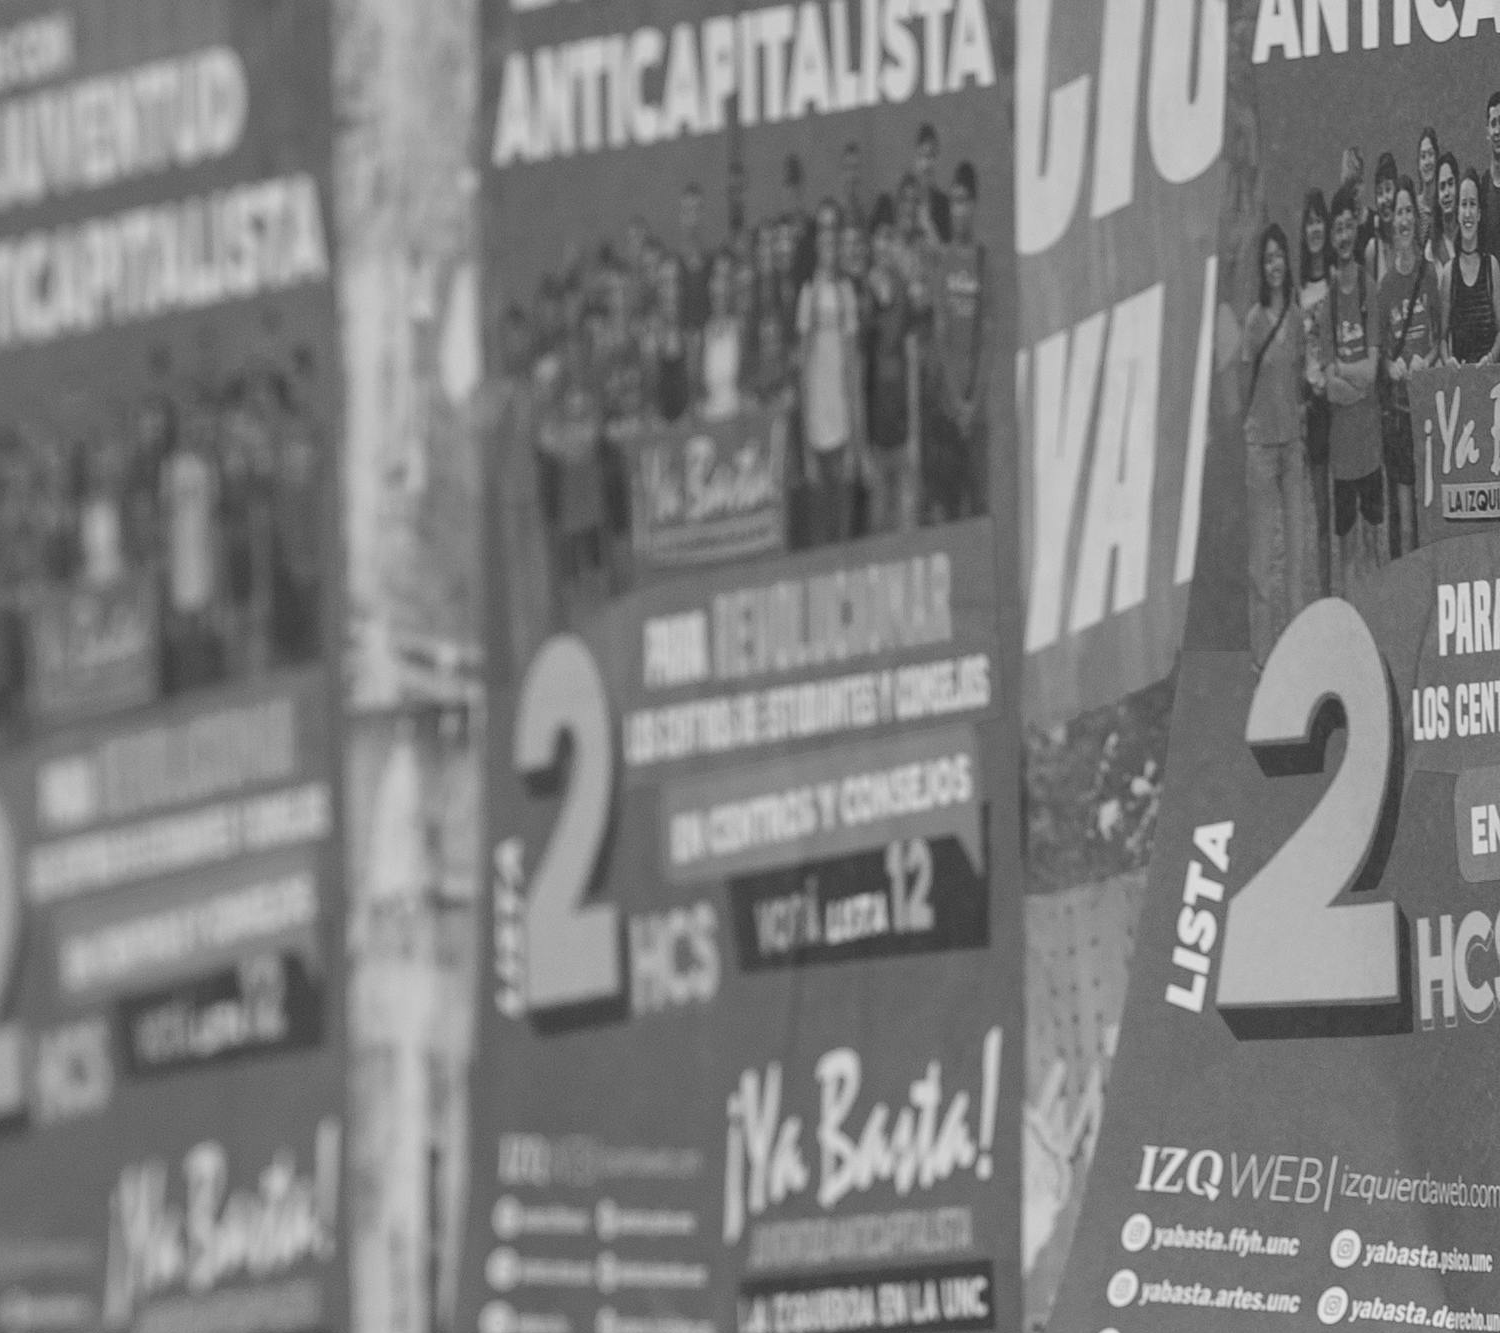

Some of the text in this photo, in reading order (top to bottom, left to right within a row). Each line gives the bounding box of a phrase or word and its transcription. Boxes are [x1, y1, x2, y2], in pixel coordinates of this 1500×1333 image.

[493, 0, 996, 167] ANTICAPITALISTA
[1412, 686, 1450, 742] LOS
[514, 632, 620, 1010] 2
[1215, 596, 1398, 1005] 2
[1165, 820, 1235, 1013] LISTA
[1138, 1280, 1300, 1313] yabasta.artes.unc
[1363, 1240, 1492, 1274] yabasta.psico.unc
